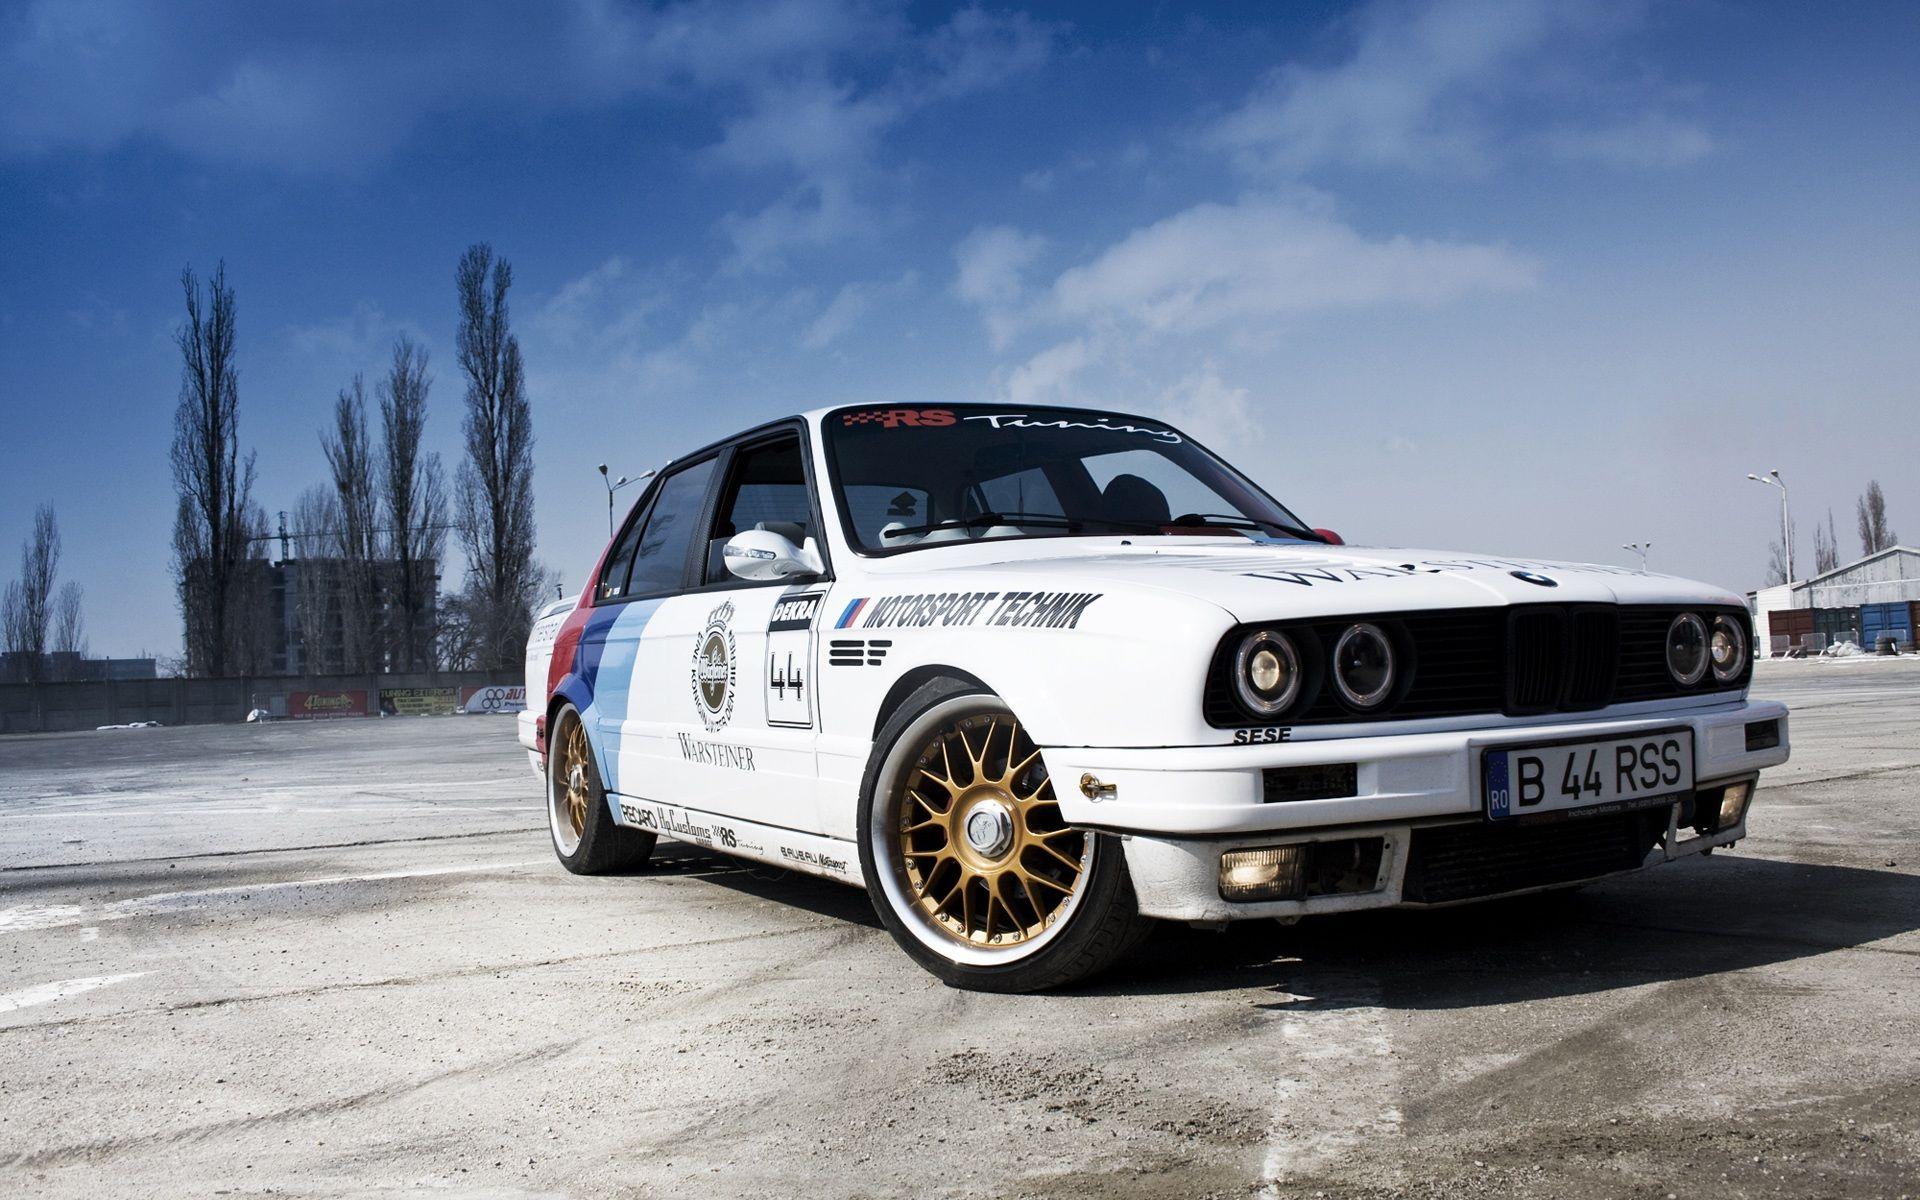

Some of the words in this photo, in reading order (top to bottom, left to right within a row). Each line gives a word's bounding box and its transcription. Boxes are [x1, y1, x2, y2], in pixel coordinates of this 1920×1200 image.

[883, 409, 957, 428] RS
[963, 414, 1184, 444] Tuning
[771, 600, 817, 622] DEKRA
[862, 591, 1000, 630] MOTORSPORT
[985, 591, 1104, 630] TECHNIK
[770, 651, 804, 702] 44
[380, 688, 411, 698] TUNING
[414, 688, 456, 697] EXTERIOR
[724, 690, 736, 721] DEN
[1234, 727, 1292, 745] SESE
[677, 732, 756, 771] WARSTEINER
[1517, 756, 1545, 807] B
[1561, 749, 1602, 800] 44
[1616, 739, 1681, 794] RSS
[1491, 789, 1509, 811] RO
[620, 804, 658, 830] RECARO
[719, 826, 738, 848] RS
[737, 839, 764, 856] Tuning
